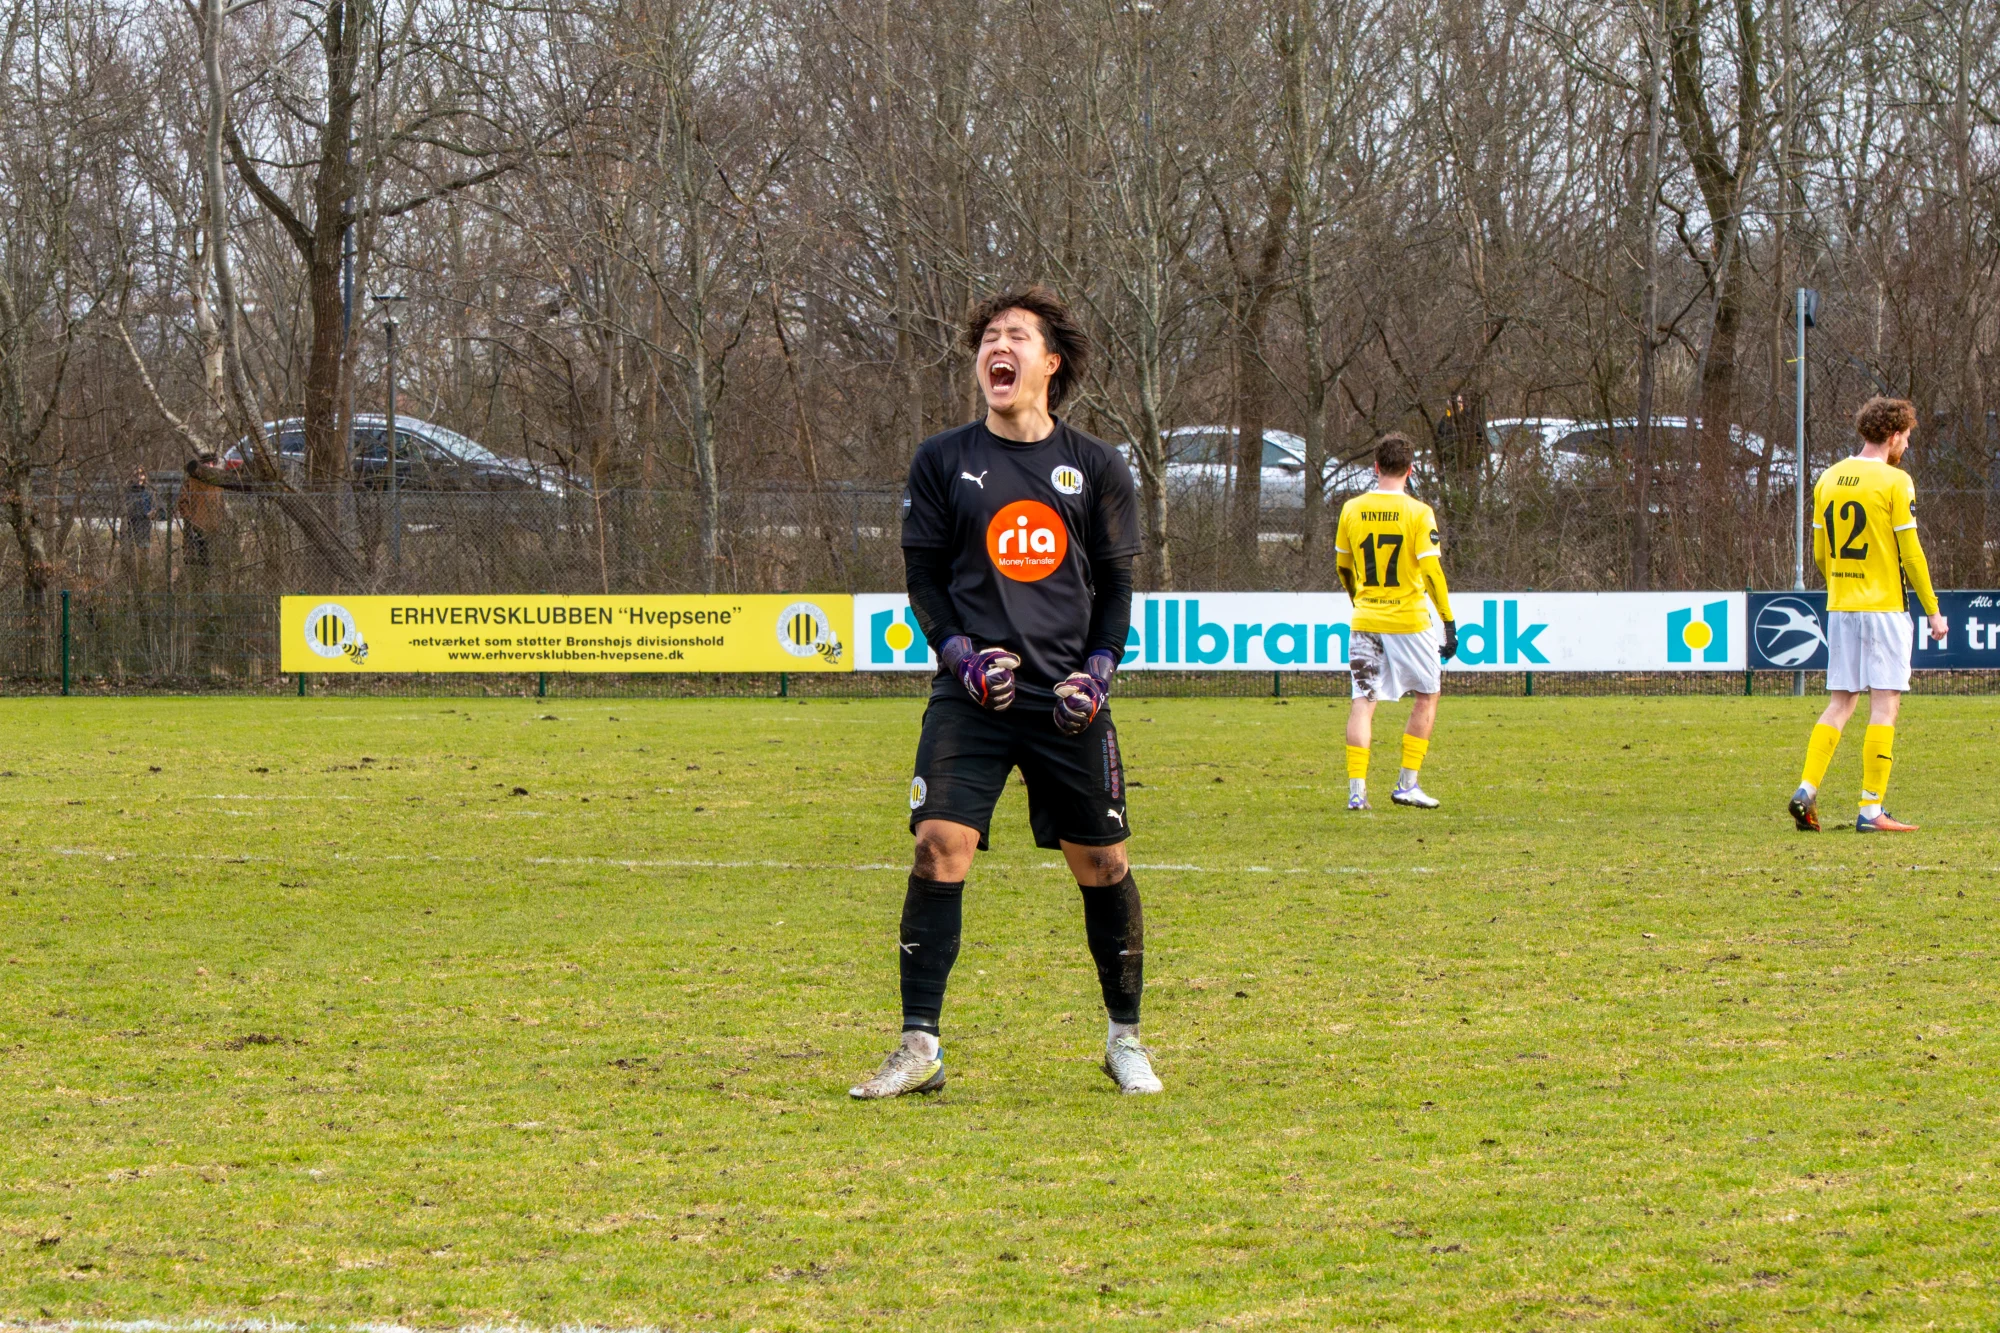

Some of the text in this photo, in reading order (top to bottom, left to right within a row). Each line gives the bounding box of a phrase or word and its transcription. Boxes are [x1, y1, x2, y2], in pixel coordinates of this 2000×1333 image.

[1836, 475, 1860, 487] HALD
[1361, 511, 1400, 522] WINTHER
[998, 515, 1056, 554] ria
[1823, 500, 1868, 560] 12
[998, 557, 1055, 567] Money Transfer
[1359, 532, 1404, 587] 17
[1968, 595, 1993, 608] Alle
[390, 607, 613, 625] ERHVERVSKLUBBEN
[408, 636, 724, 648] -netværket som støtter Brønshøjs divisionshold
[448, 649, 684, 661] www.erhvervsklubben-hvepsene.dk
